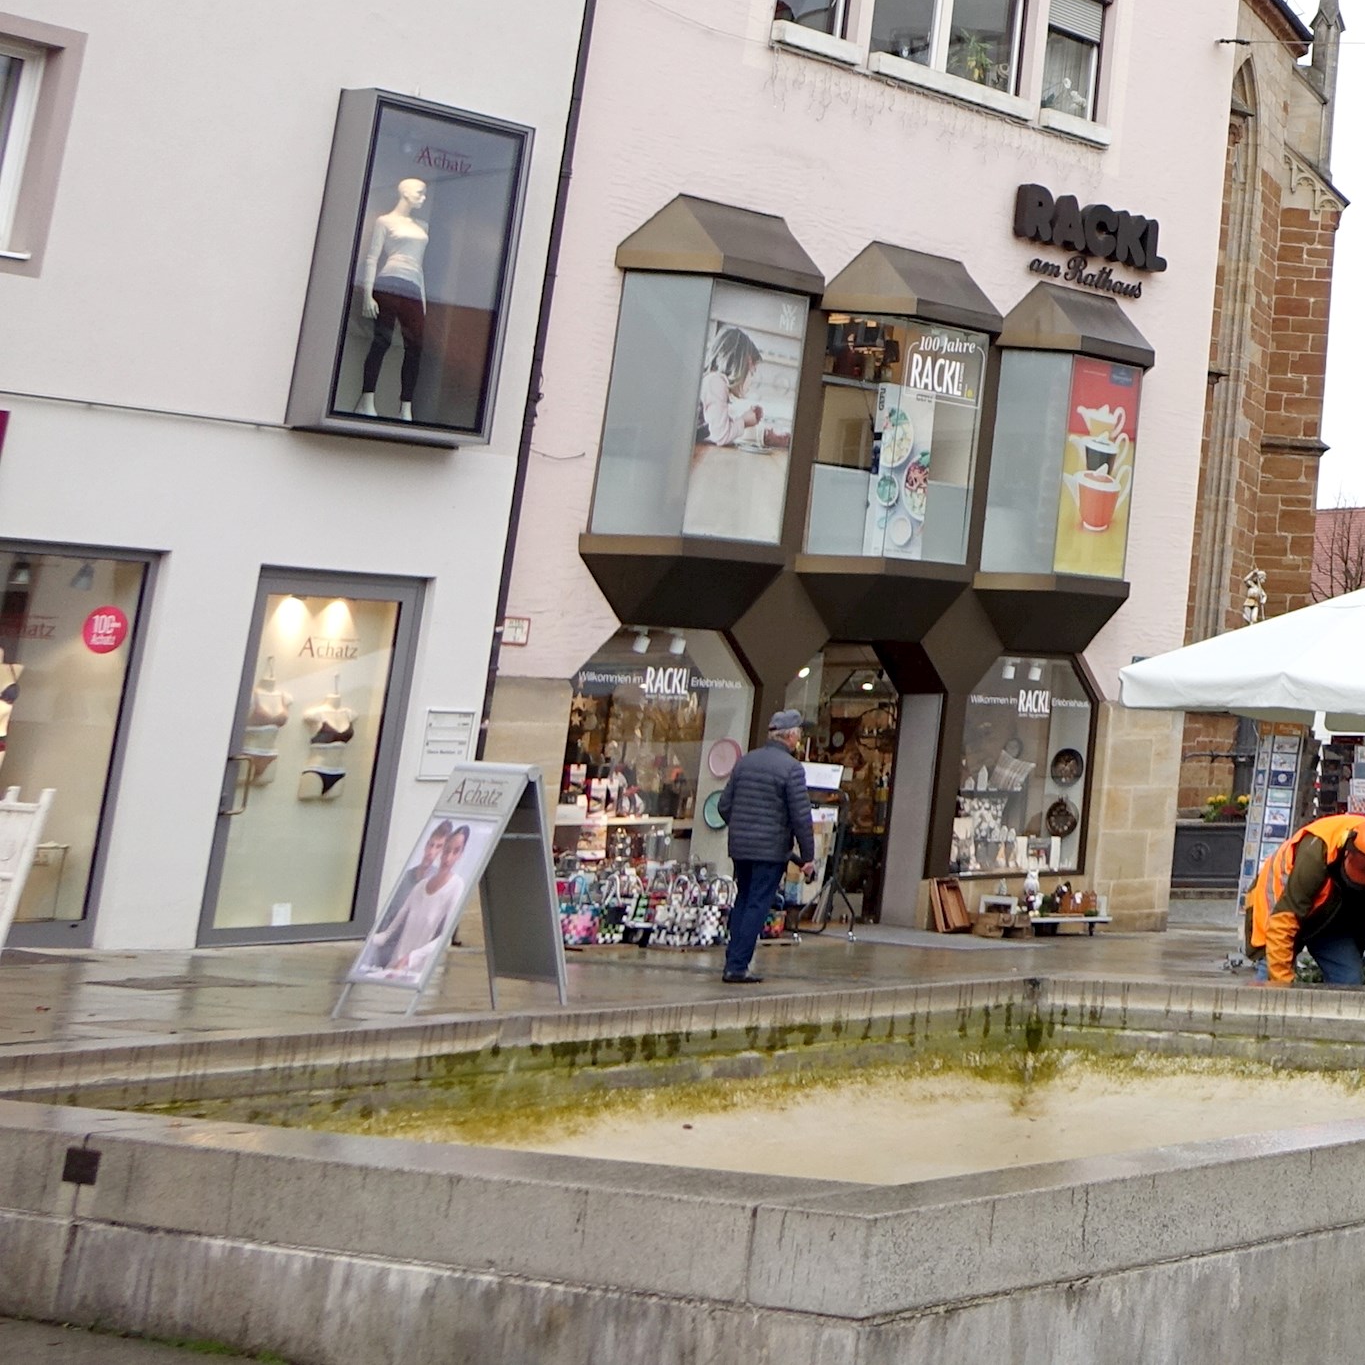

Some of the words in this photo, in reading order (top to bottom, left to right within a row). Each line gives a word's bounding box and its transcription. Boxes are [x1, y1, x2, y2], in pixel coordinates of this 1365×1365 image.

[1014, 183, 1168, 272] RACKL
[1029, 257, 1061, 278] am
[1064, 255, 1142, 299] Rathaus
[919, 336, 940, 351] 100
[940, 336, 976, 354] Jahre
[910, 353, 962, 396] RACKL
[298, 635, 358, 660] Achatz
[578, 671, 632, 685] Willkommen
[632, 674, 644, 684] im
[645, 666, 688, 695] RACKL
[690, 676, 742, 689] Erlebnishaus
[970, 694, 1009, 705] Willkommen
[1018, 689, 1050, 714] RACKL
[1050, 698, 1089, 708] Erlebnishaus
[447, 778, 503, 806] Achatz
